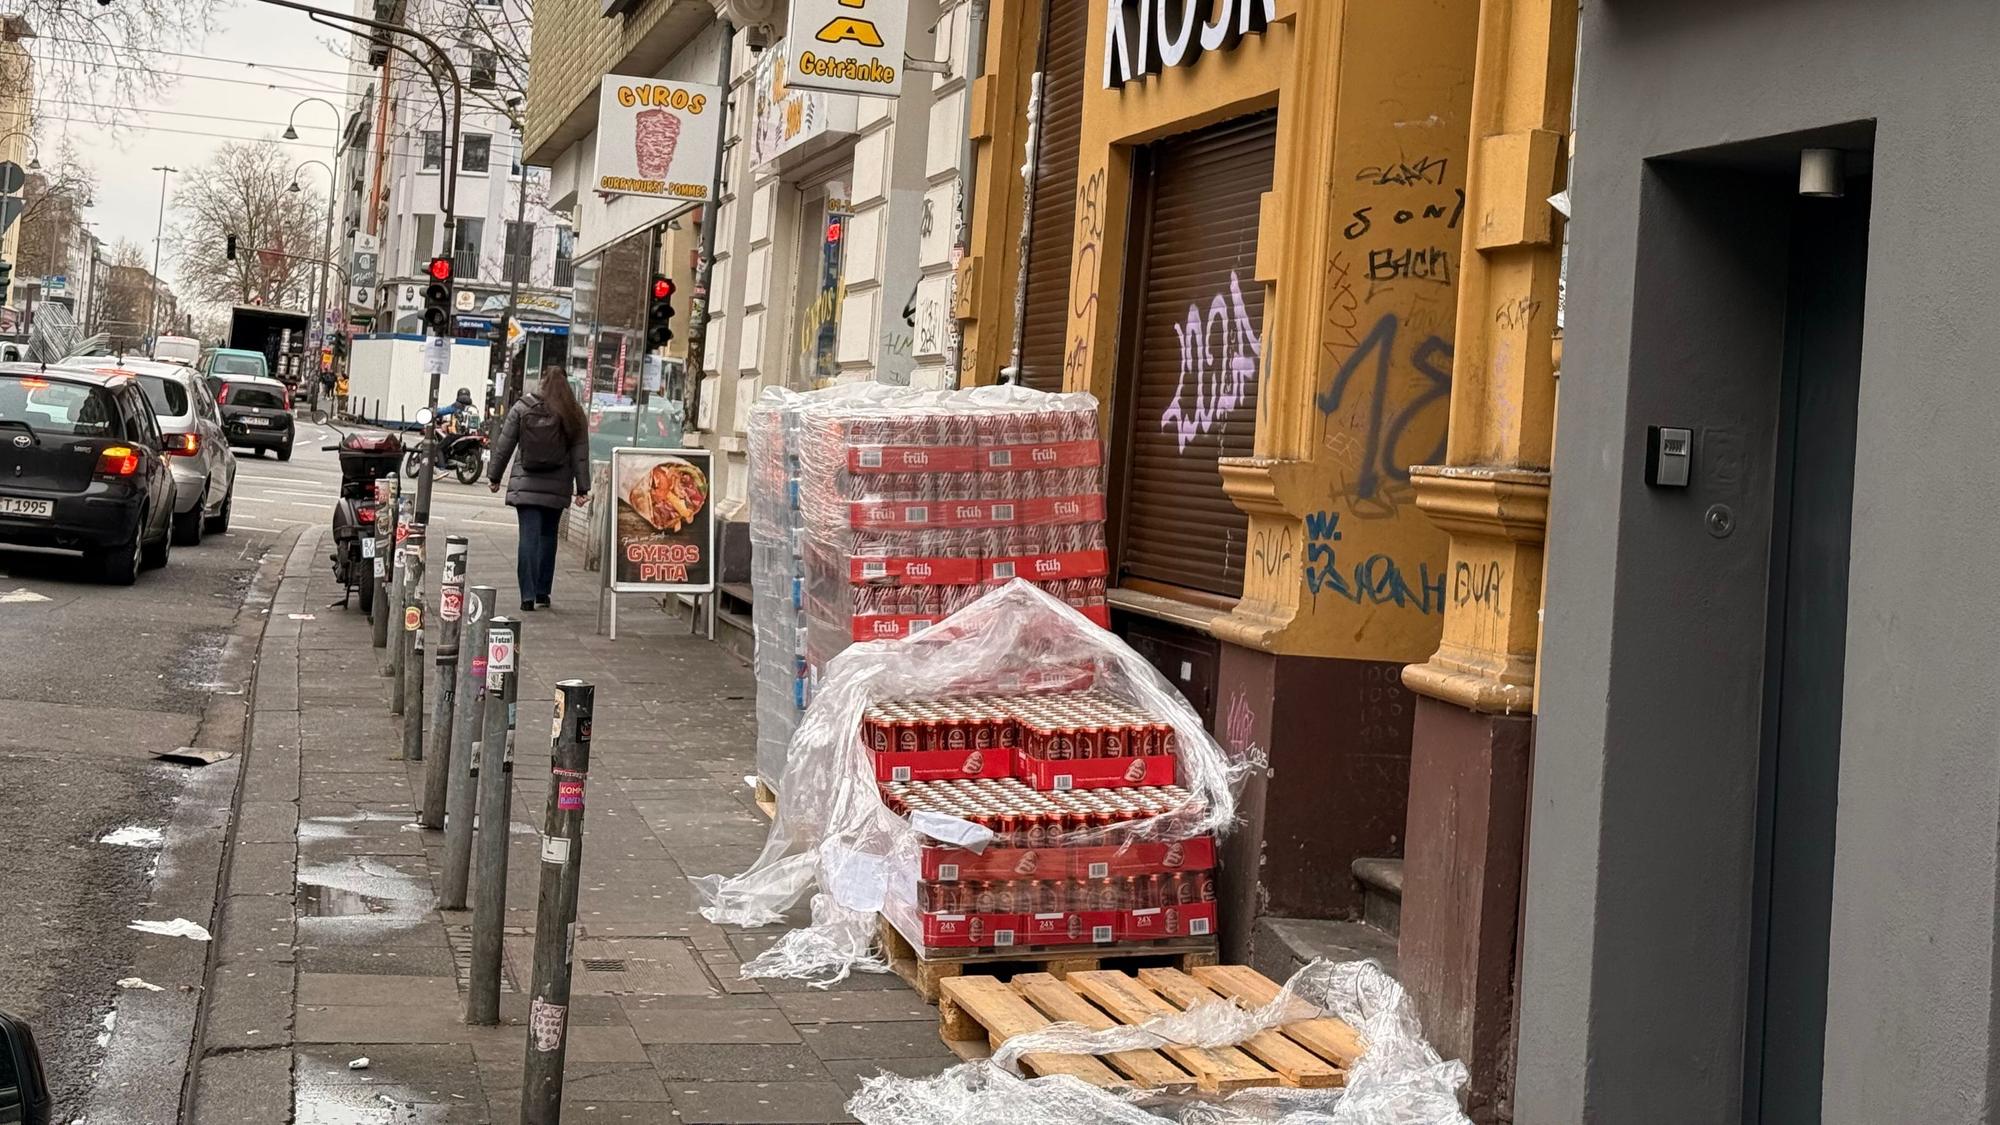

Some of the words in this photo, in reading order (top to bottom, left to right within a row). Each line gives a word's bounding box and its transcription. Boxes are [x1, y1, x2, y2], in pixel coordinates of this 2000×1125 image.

[800, 51, 895, 83] Getränke
[618, 84, 707, 114] GYROS
[903, 450, 929, 465] früh
[1032, 447, 1057, 461] früh
[13, 499, 48, 514] 1995
[871, 506, 895, 521] früh
[957, 505, 982, 520] früh
[1054, 502, 1079, 516] früh
[627, 544, 700, 562] GYROS
[641, 563, 688, 581] PITA
[906, 562, 932, 577] früh
[1035, 559, 1061, 574] früh
[873, 619, 899, 634] früh
